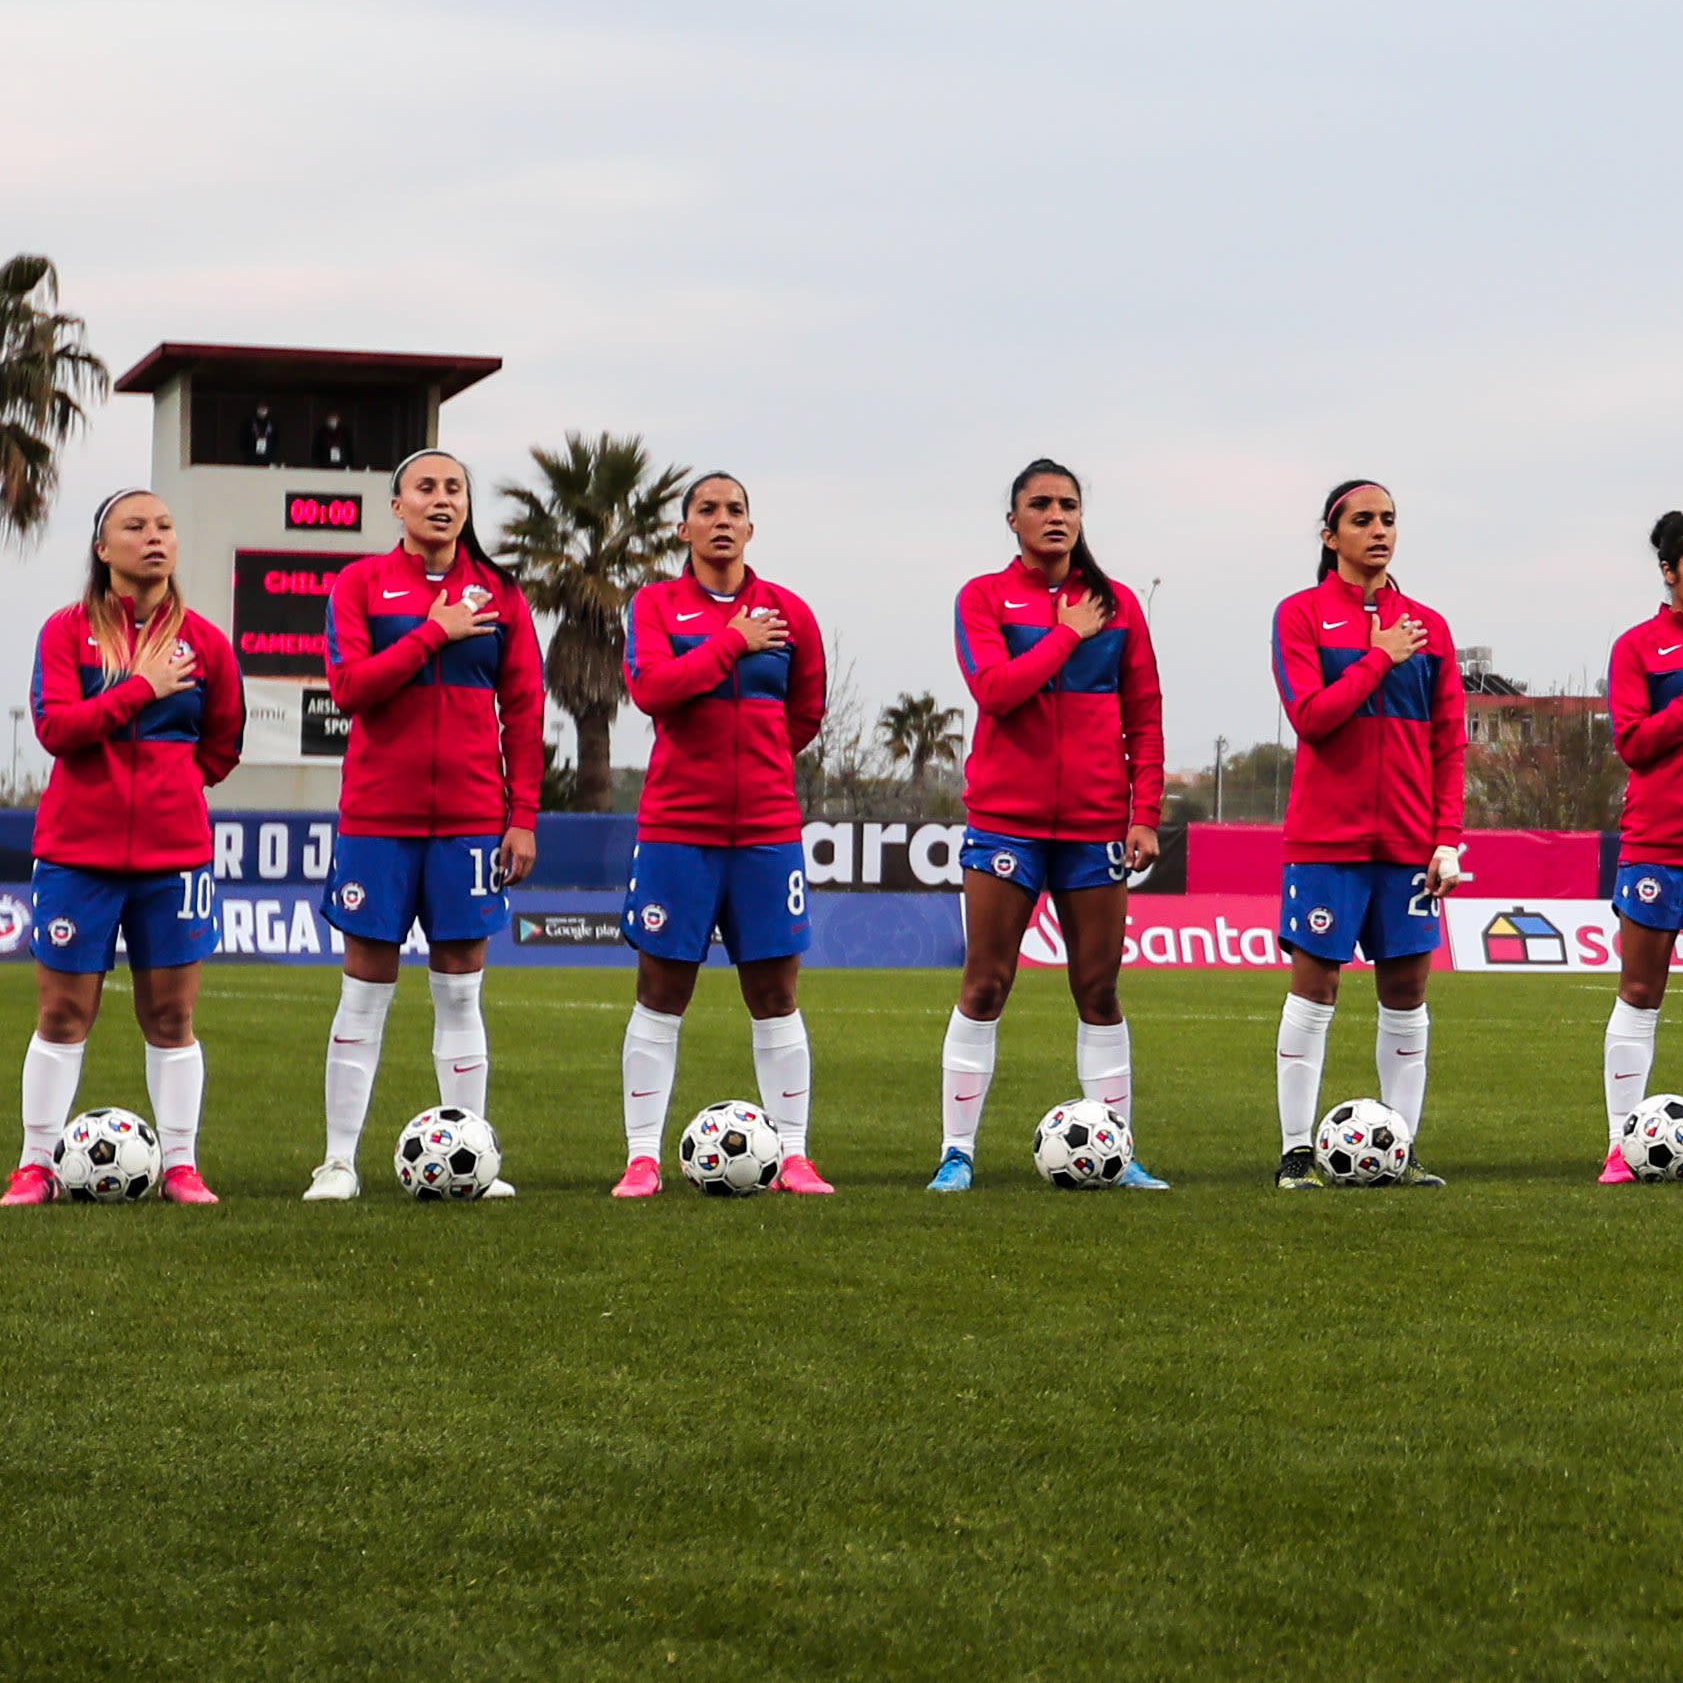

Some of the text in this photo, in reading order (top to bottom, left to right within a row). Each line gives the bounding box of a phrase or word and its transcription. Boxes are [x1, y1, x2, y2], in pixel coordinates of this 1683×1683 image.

[290, 498, 357, 524] 00:00
[1106, 841, 1125, 881] 9
[177, 872, 211, 919] 10
[788, 870, 805, 916] 8
[545, 922, 620, 941] Google play
